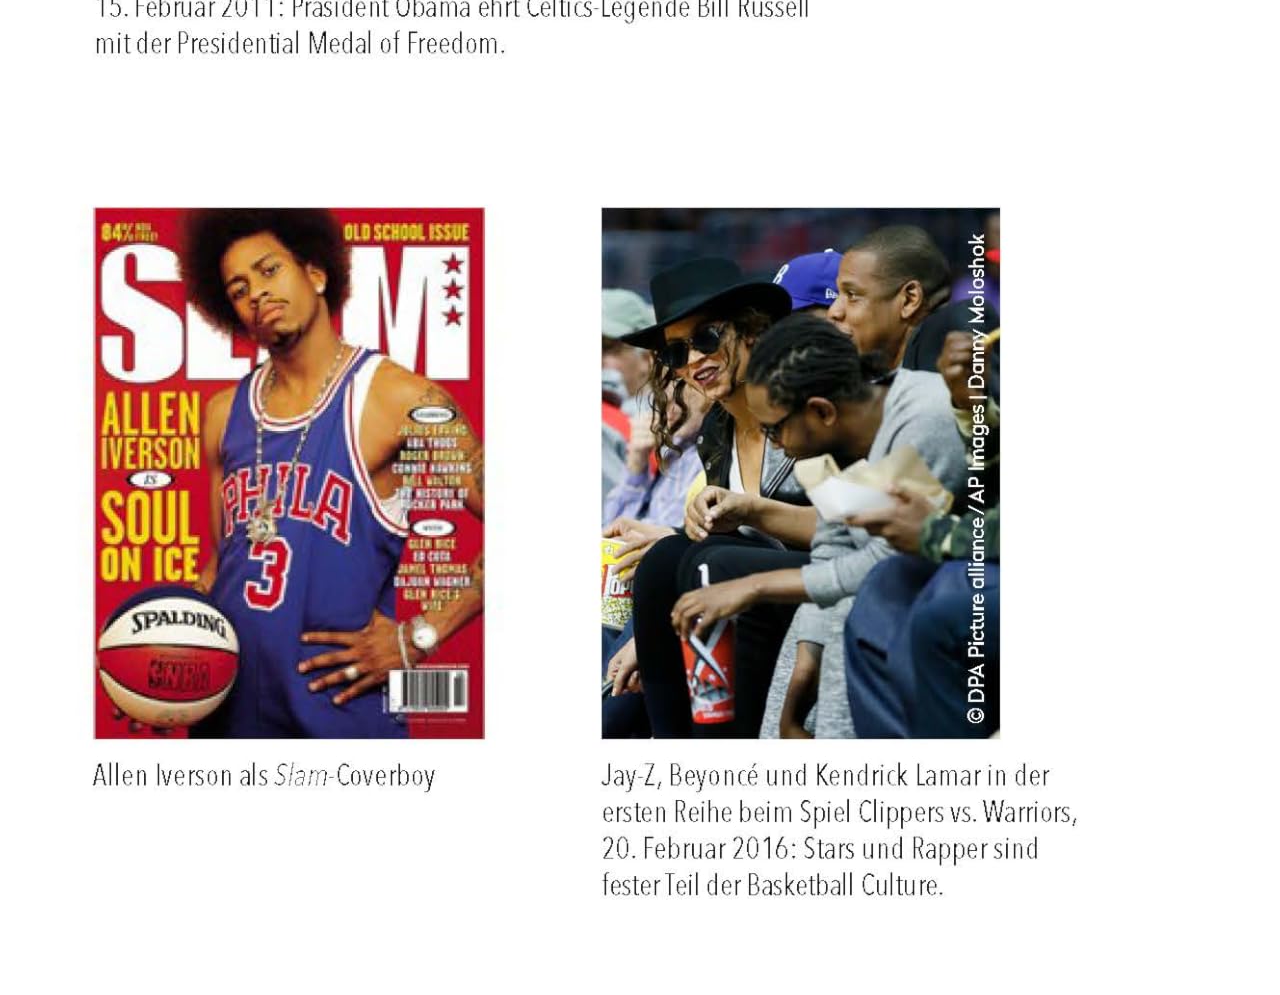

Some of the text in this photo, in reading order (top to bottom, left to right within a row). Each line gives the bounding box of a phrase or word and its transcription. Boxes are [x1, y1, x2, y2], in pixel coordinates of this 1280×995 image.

[343, 222, 471, 242] OLD SCHOOL ISSUE
[101, 243, 470, 384] SLM
[101, 391, 200, 436] ALLEN
[101, 436, 200, 470] IVERSON
[101, 490, 200, 545] SOUL
[222, 462, 352, 546] PHILA
[101, 546, 200, 582] ON ICE
[244, 537, 293, 612] 3
[131, 609, 227, 639] SPALDING
